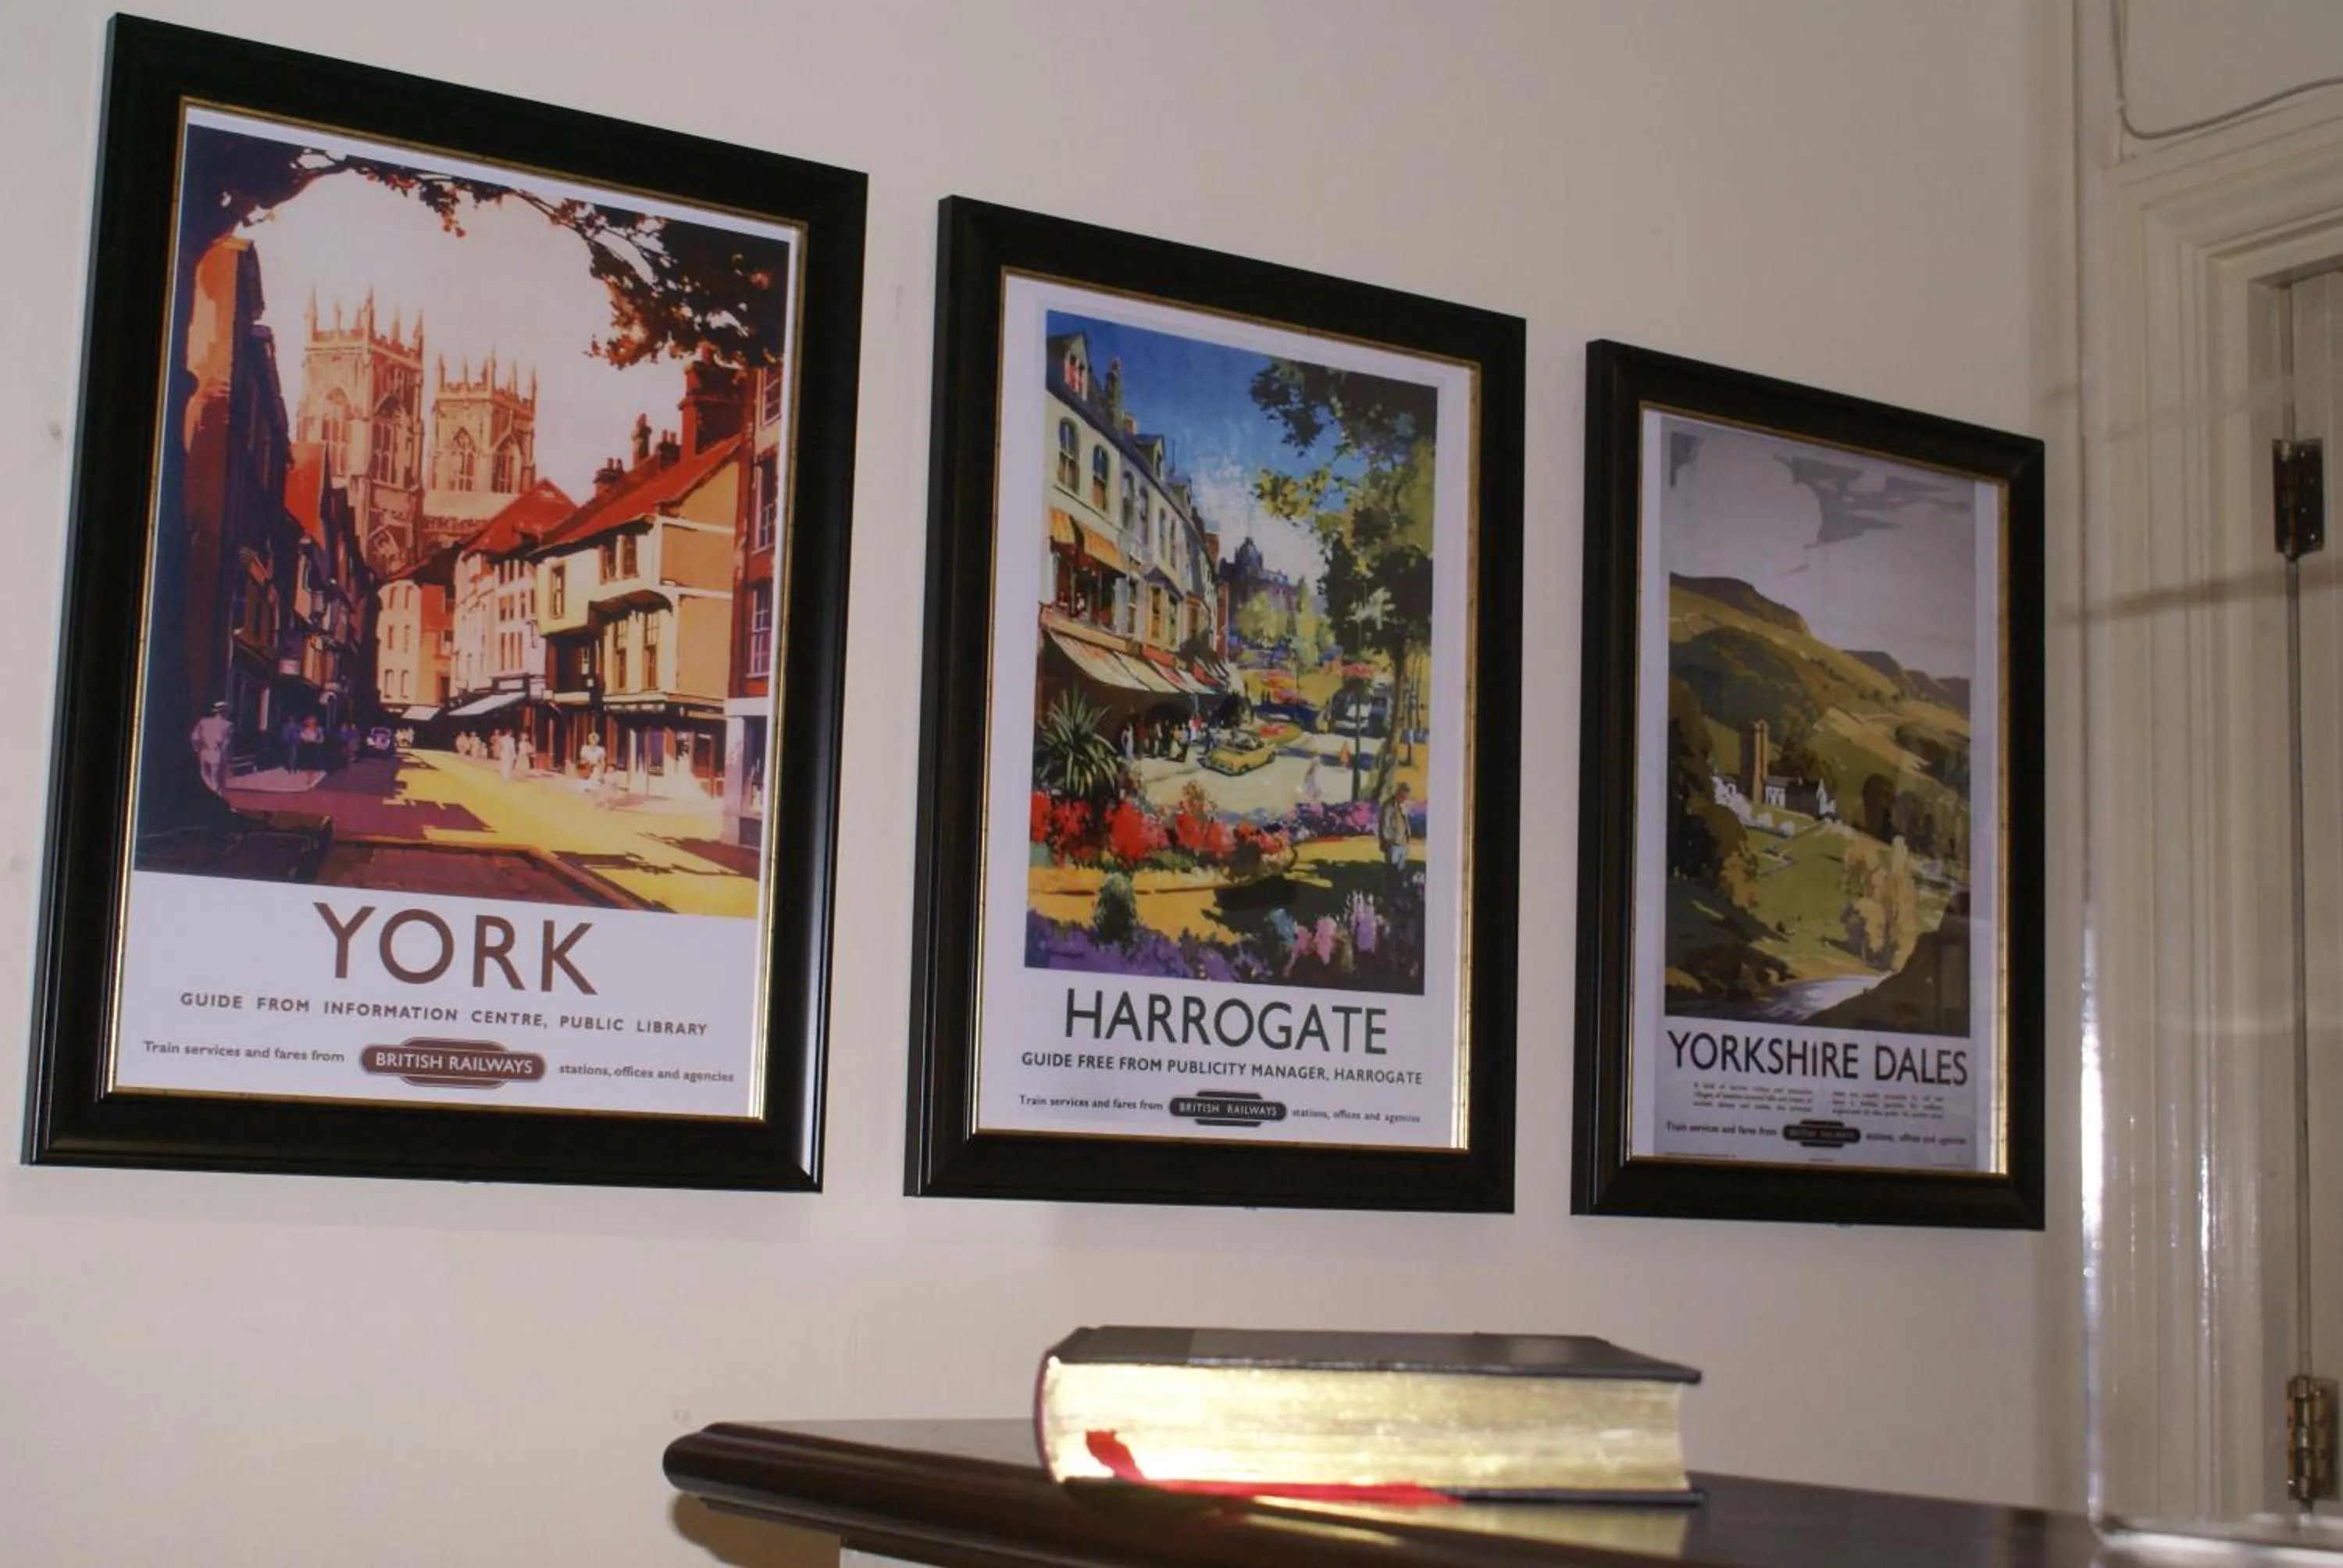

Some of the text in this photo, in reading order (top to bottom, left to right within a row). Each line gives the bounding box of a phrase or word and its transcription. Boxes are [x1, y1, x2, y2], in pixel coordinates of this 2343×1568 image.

[312, 902, 597, 996] YORK
[180, 992, 708, 1036] GUIDE FROM INFORMATION CENTRE, PUBLIC LIBRARY
[1065, 988, 1387, 1055] HARROGATE
[143, 1040, 344, 1062] Train services and fares from
[1667, 1030, 1967, 1086] YORKSHIRE DALES
[376, 1052, 533, 1074] BRITISH RAILWAYS
[559, 1063, 734, 1083] stations, offices and agencies
[1022, 1052, 1422, 1085] GUIDE FREE FROM PUBLICITY MANAGER, HARROGATE
[1019, 1095, 1163, 1110] Train services and fares from
[1179, 1101, 1277, 1115] BRITISH RAILWAYS
[1364, 1112, 1380, 1121] and
